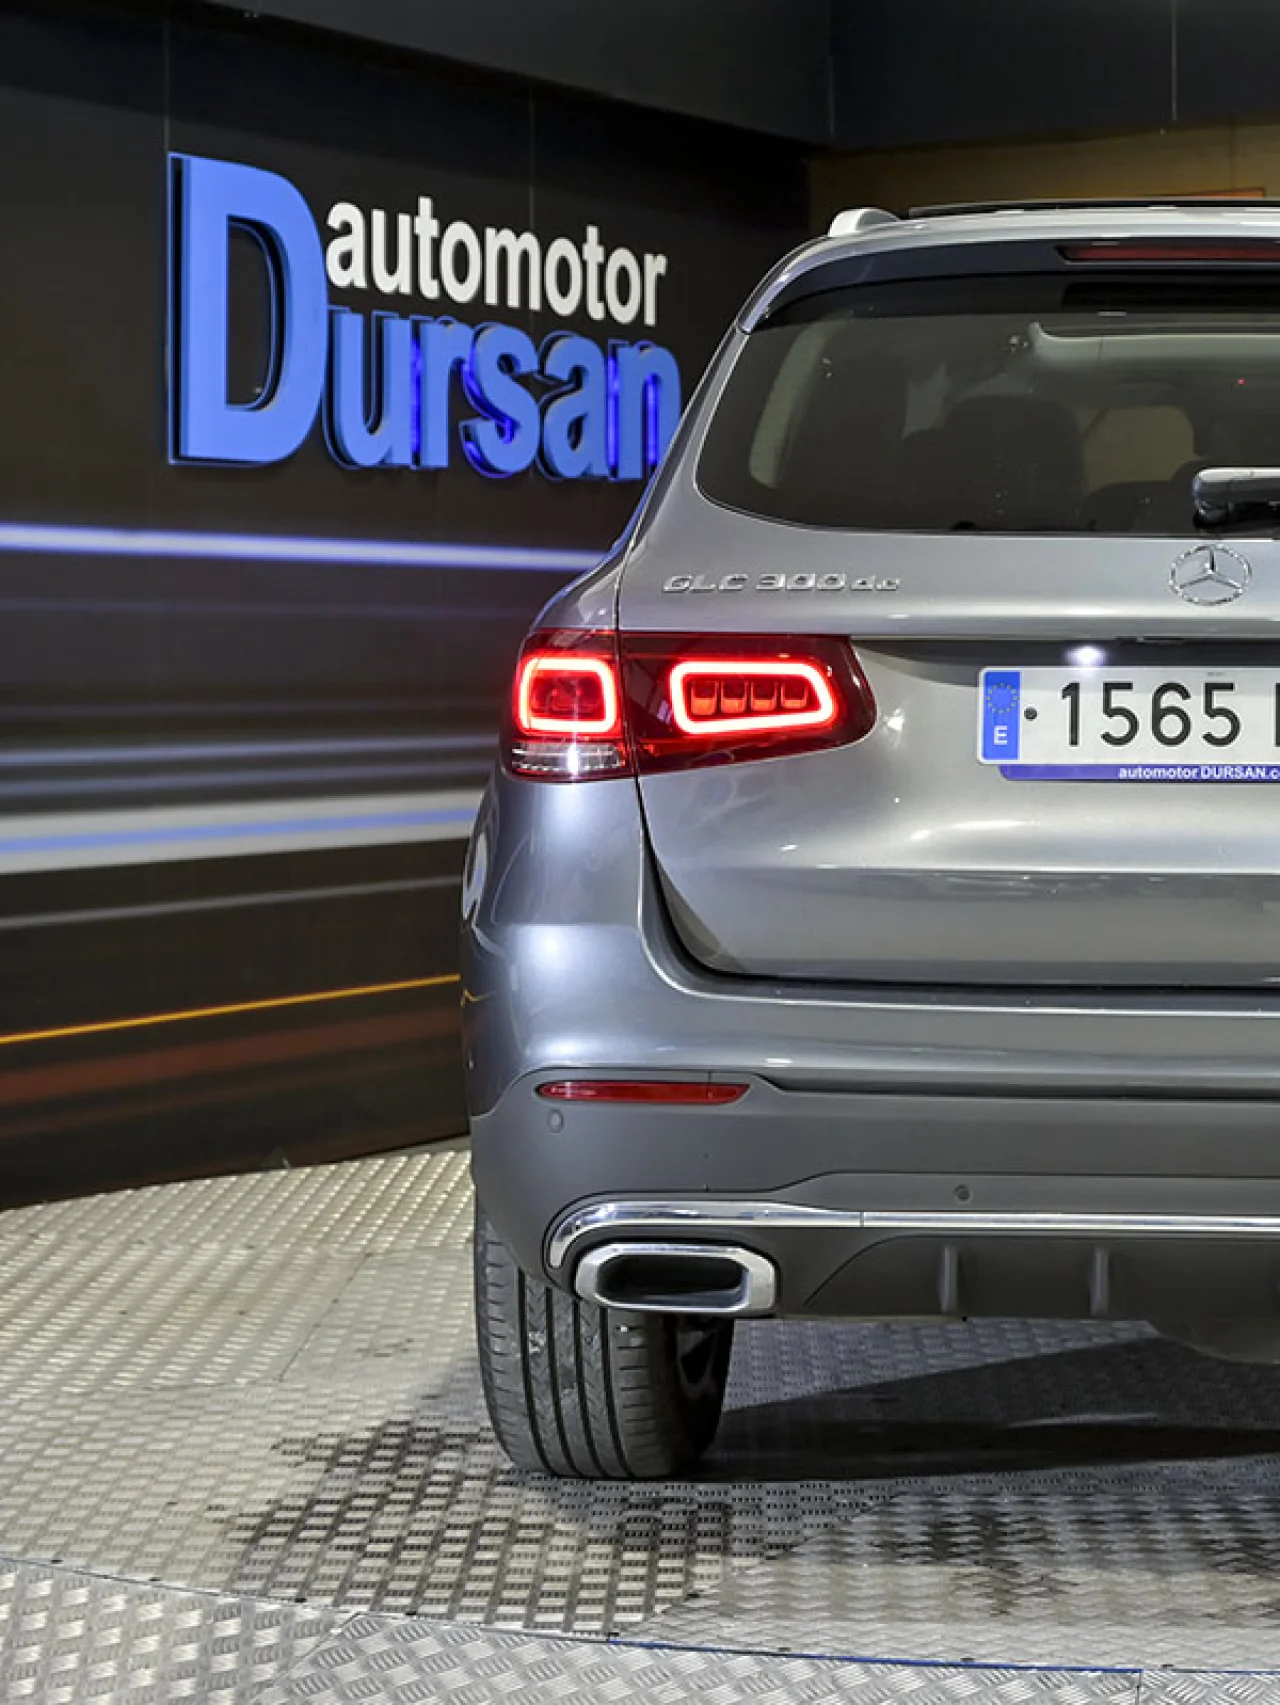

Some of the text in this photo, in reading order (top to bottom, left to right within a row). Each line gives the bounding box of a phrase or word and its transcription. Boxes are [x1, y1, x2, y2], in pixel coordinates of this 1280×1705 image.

[325, 196, 667, 327] automotor
[168, 151, 681, 482] Dursan
[661, 573, 749, 594] GLC
[993, 725, 1009, 746] E
[1060, 681, 1242, 748] 1565
